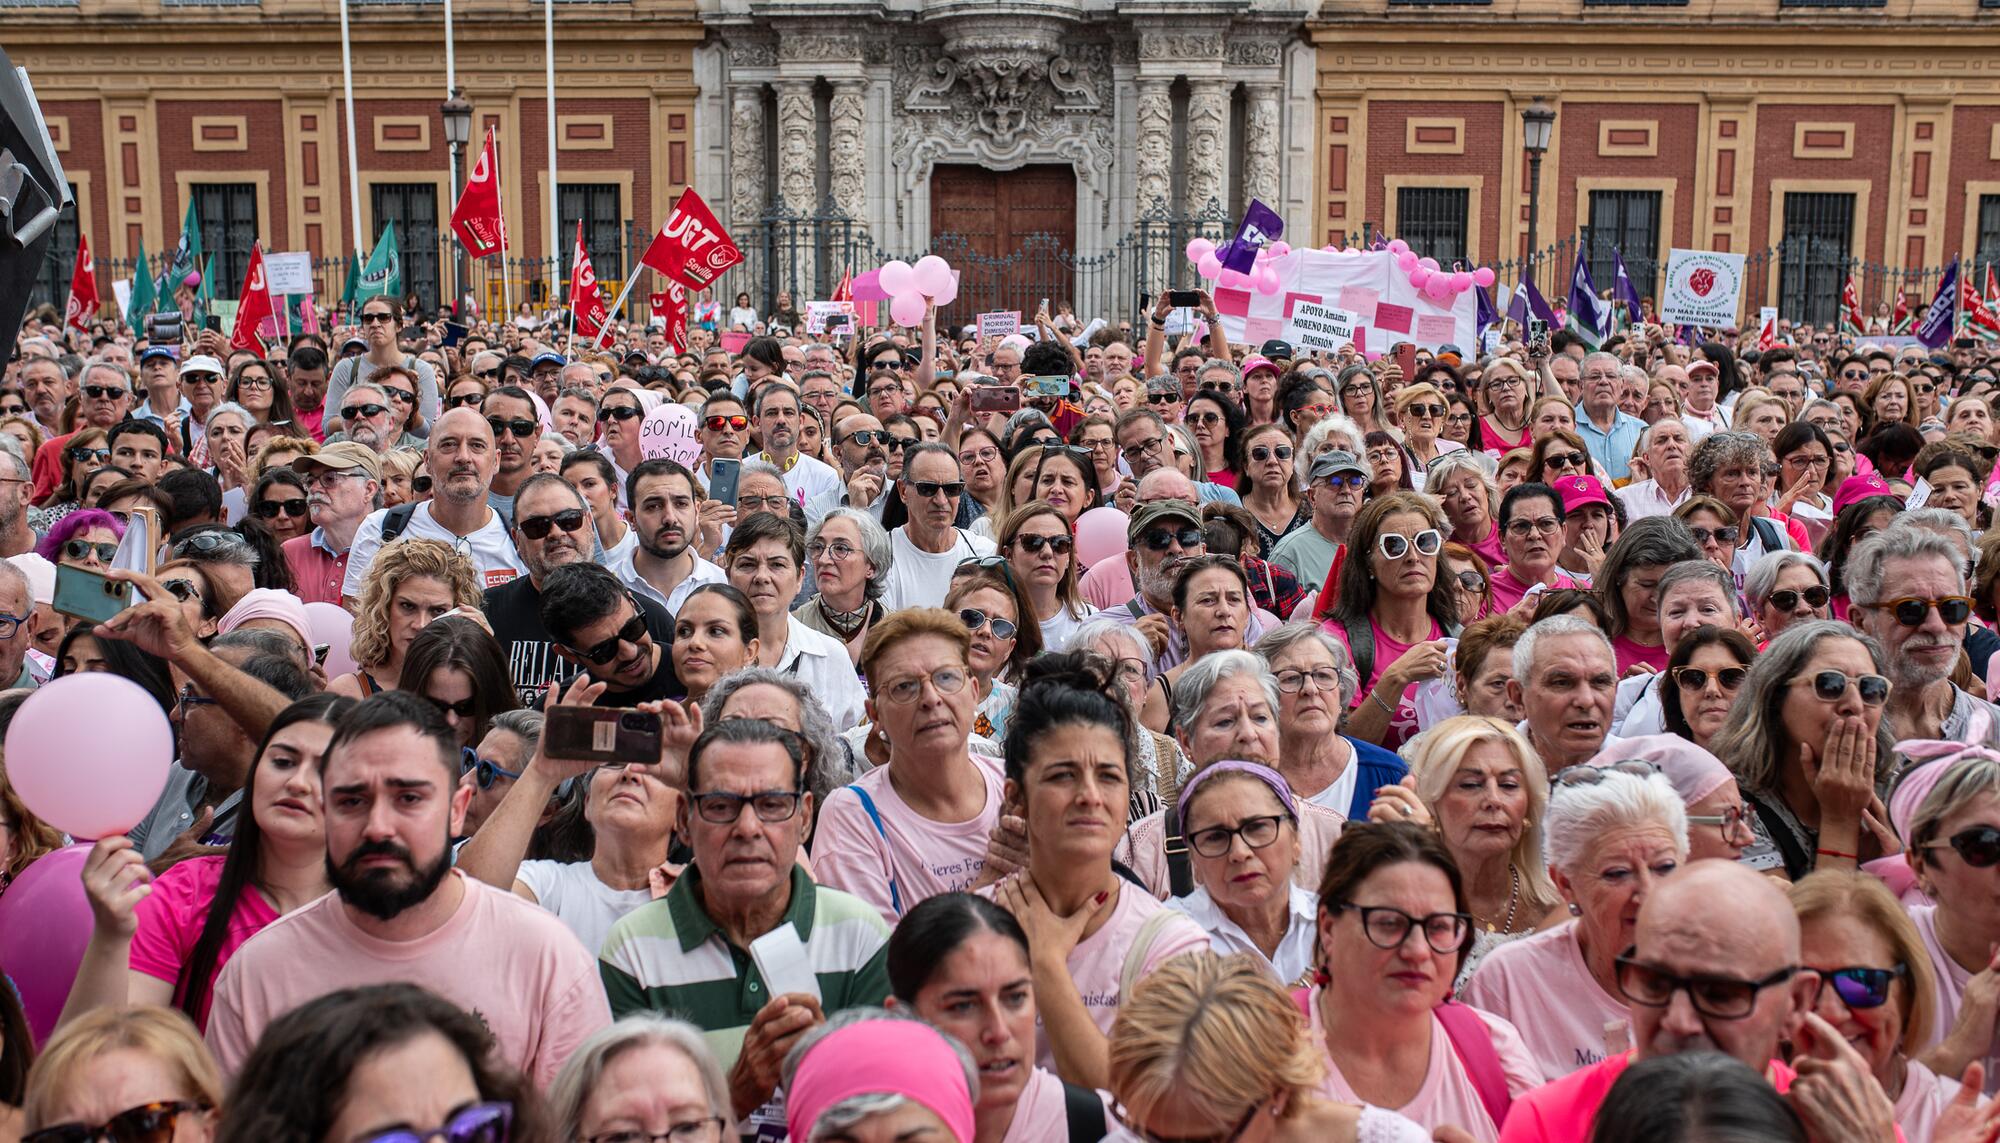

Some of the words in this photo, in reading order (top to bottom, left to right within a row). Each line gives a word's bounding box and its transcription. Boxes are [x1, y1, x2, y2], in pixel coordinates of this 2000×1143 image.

[662, 208, 720, 252] UGT
[686, 257, 714, 280] Sevilla
[1300, 304, 1324, 318] APOYO
[1323, 309, 1347, 323] Amama
[1293, 317, 1322, 332] MORENO
[1322, 323, 1351, 339] BONILLA
[1302, 334, 1334, 349] DIMISIÓN
[487, 575, 511, 584] CCOO
[509, 640, 564, 686] BELLA
